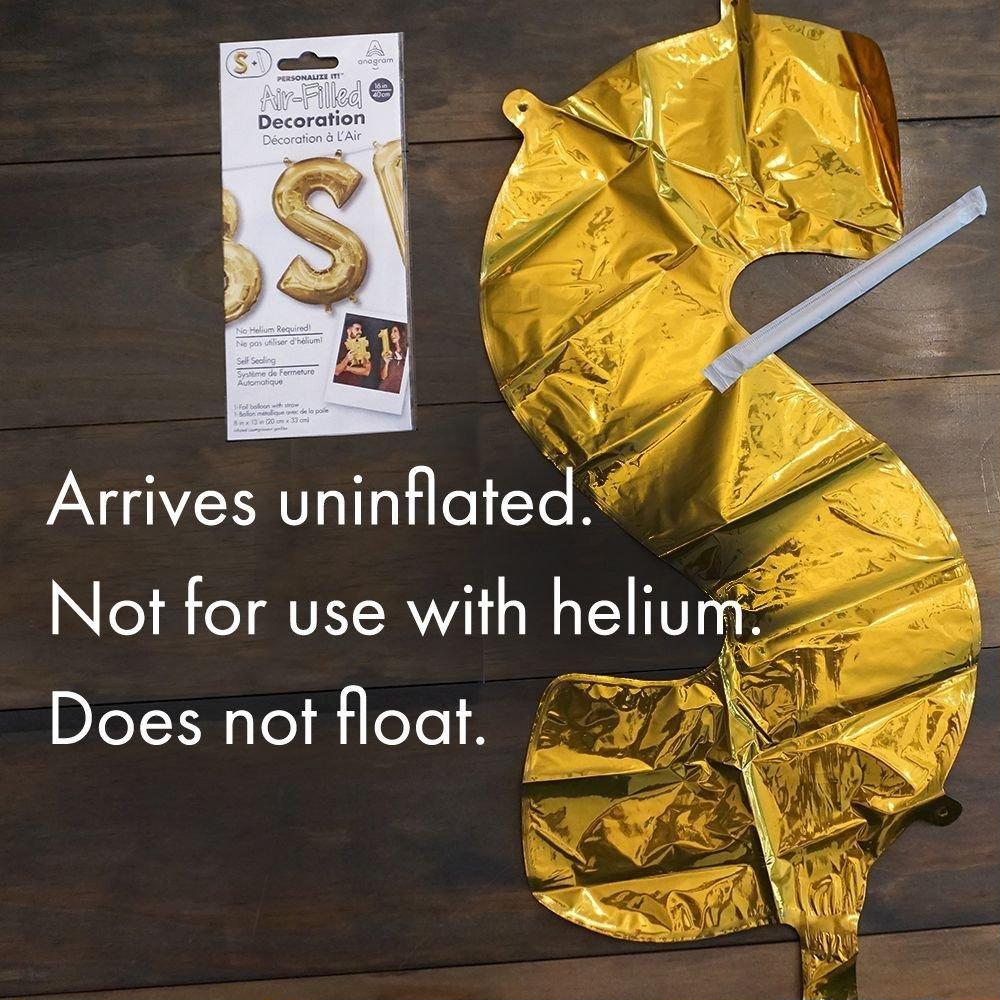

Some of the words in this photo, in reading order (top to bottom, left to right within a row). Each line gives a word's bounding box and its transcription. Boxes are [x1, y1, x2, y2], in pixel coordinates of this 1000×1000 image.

[357, 57, 394, 66] anagram
[276, 75, 329, 83] PERSONALIZE
[260, 80, 363, 112] Air-Filled
[258, 110, 365, 130] Decoration
[262, 134, 323, 146] Décoration
[326, 131, 334, 143] à
[250, 326, 275, 334] Helium
[277, 324, 311, 334] Required!
[249, 341, 262, 349] pas
[264, 338, 288, 347] utiliser
[236, 357, 249, 366] Self
[251, 356, 276, 366] Sealing
[237, 369, 266, 380] Système
[280, 368, 315, 376] Fermeture
[237, 379, 283, 388] Automatique
